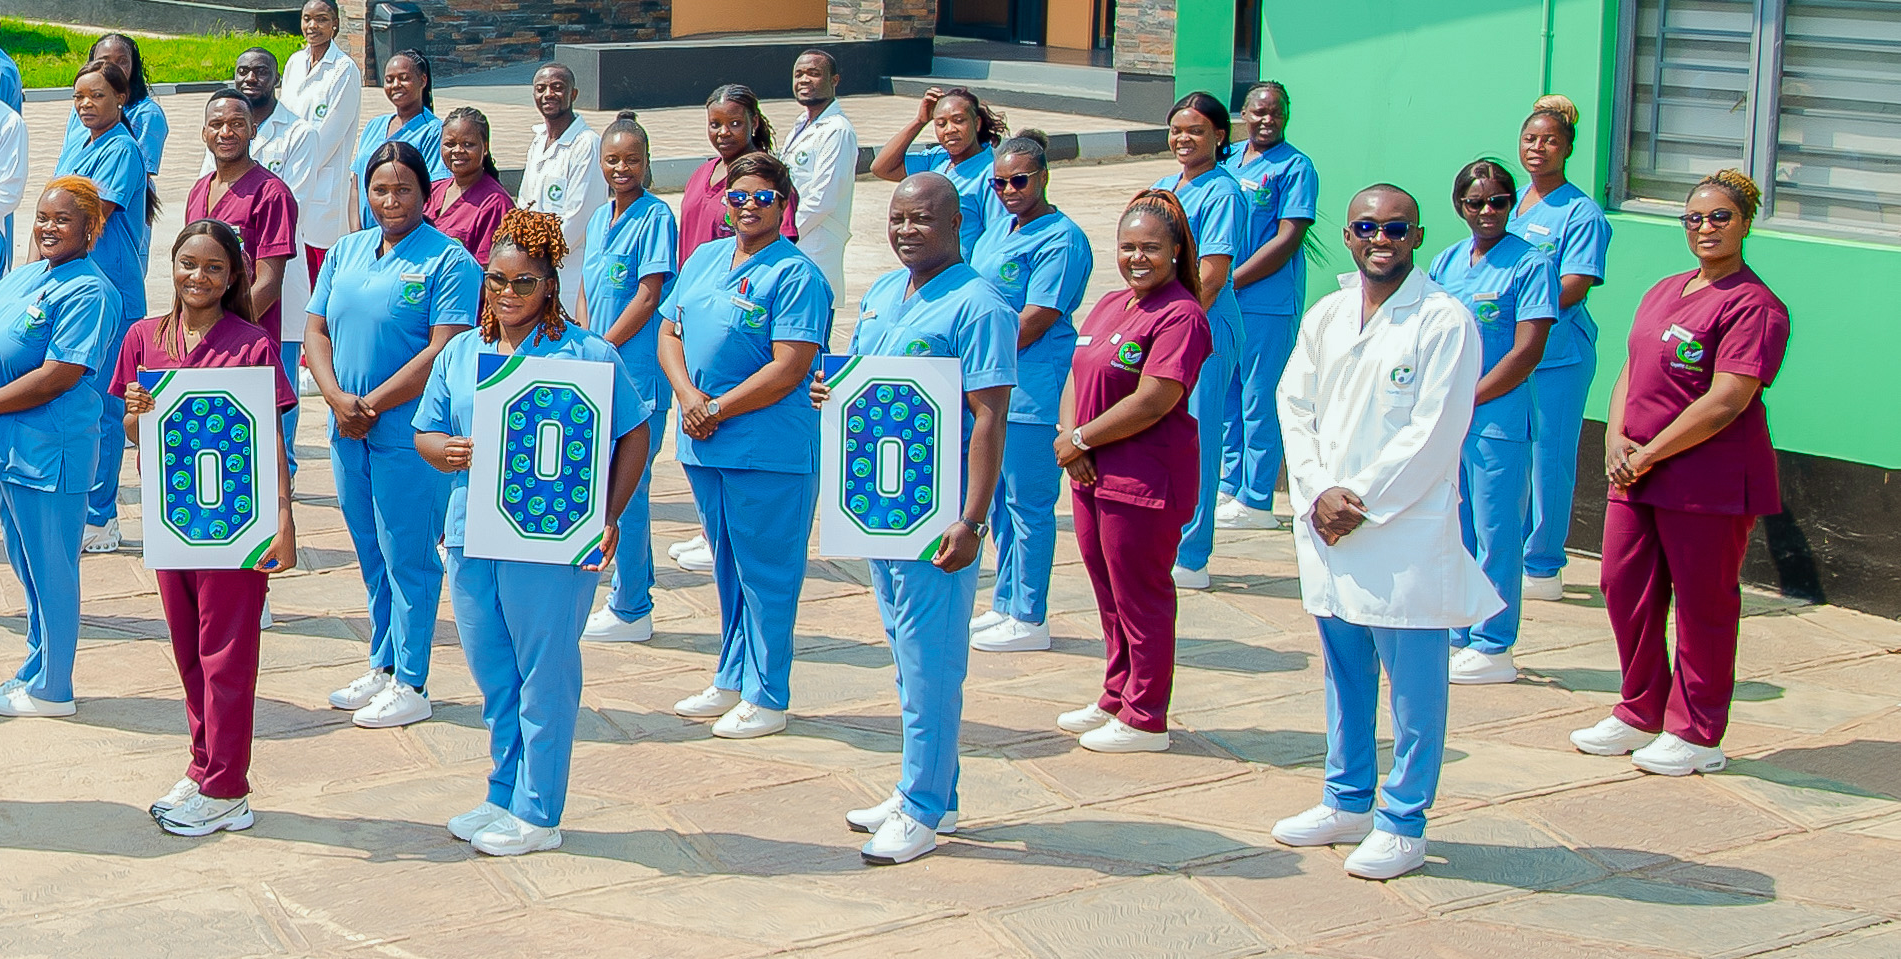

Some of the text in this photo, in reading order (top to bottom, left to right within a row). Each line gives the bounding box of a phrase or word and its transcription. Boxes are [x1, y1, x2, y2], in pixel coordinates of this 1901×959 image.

[157, 390, 257, 546] 0
[496, 379, 601, 541] 0
[839, 378, 941, 536] 0
